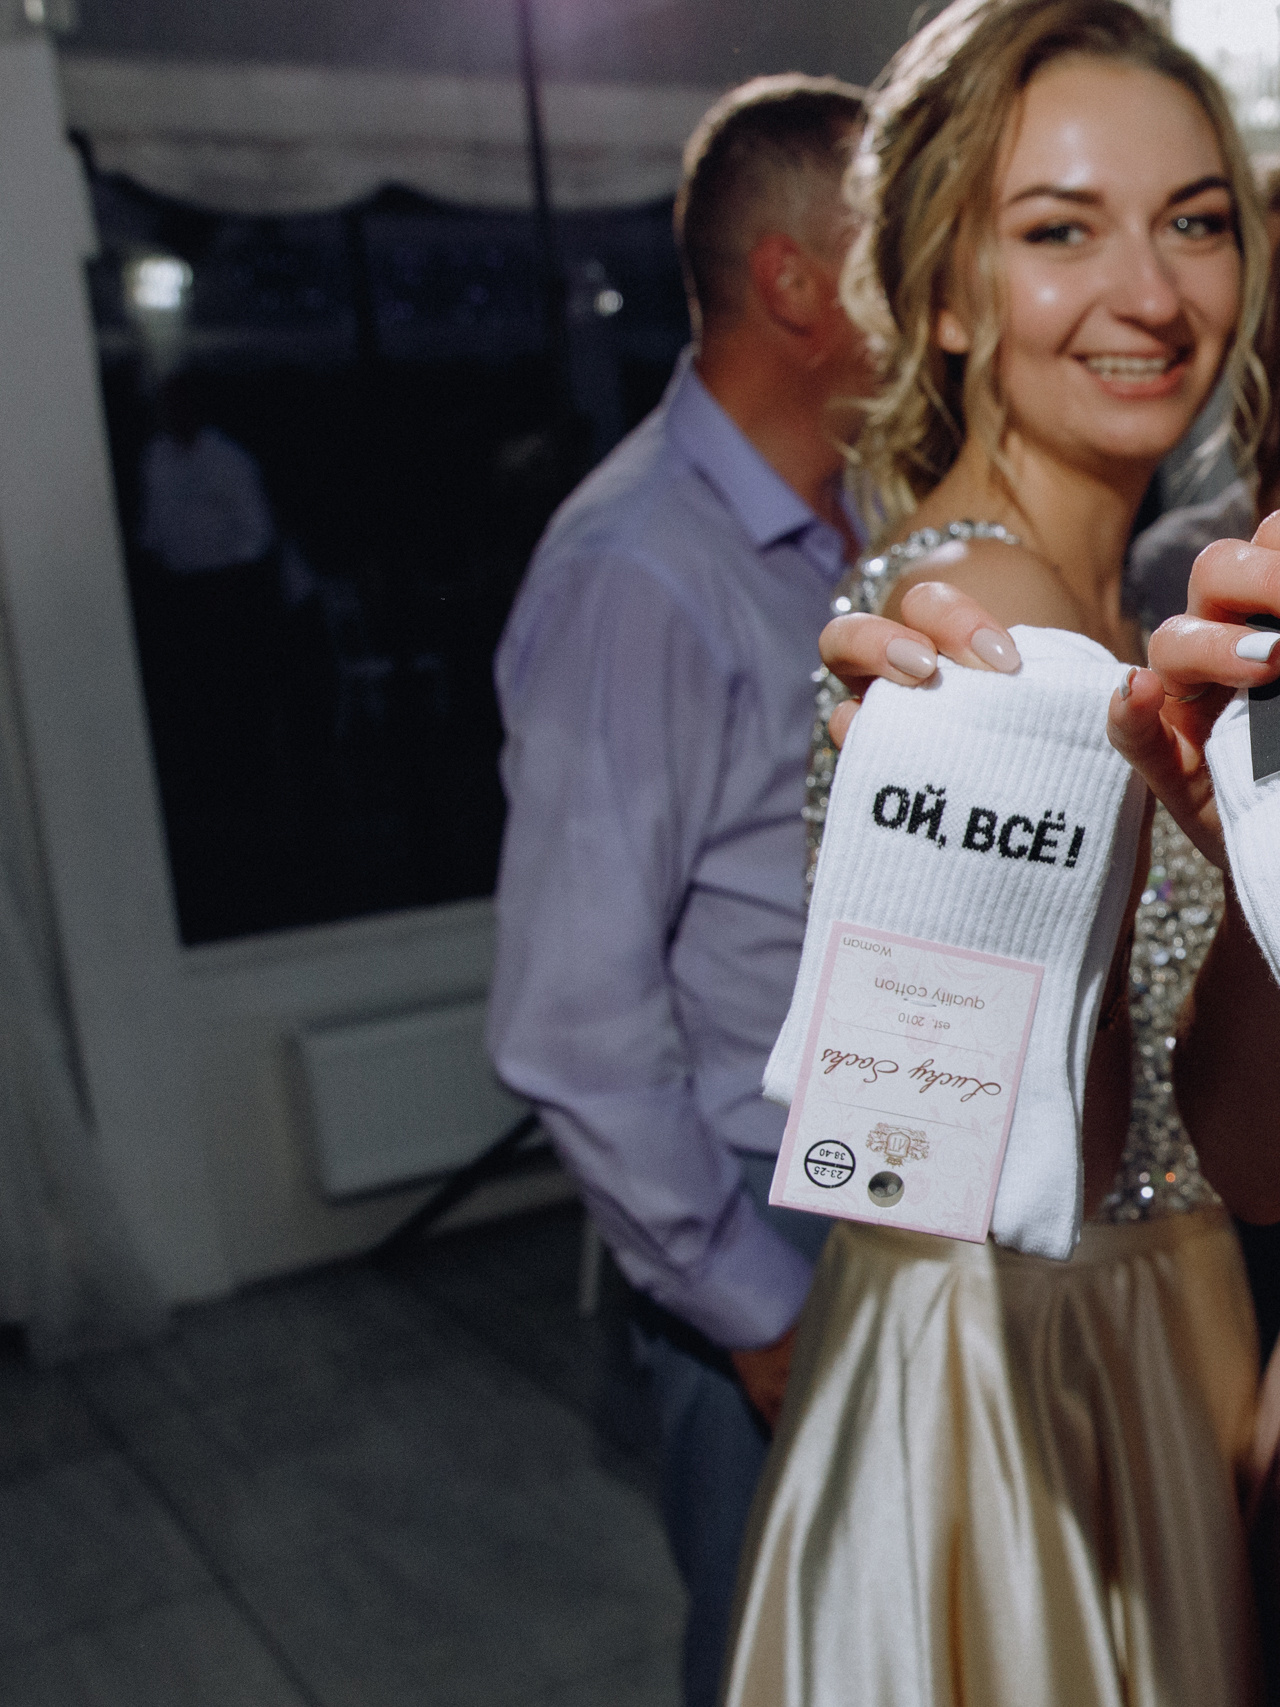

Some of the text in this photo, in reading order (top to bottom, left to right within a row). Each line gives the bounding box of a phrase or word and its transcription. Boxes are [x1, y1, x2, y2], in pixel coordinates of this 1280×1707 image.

[872, 784, 1085, 868] ОЙ, ВСЁ!
[843, 936, 892, 958] Woman
[874, 977, 986, 1010] quality cotton
[898, 1012, 951, 1030] est. 2010
[820, 1048, 1002, 1102] Lucky Socks
[819, 1148, 846, 1161] 38-40
[813, 1165, 844, 1180] 23-25
